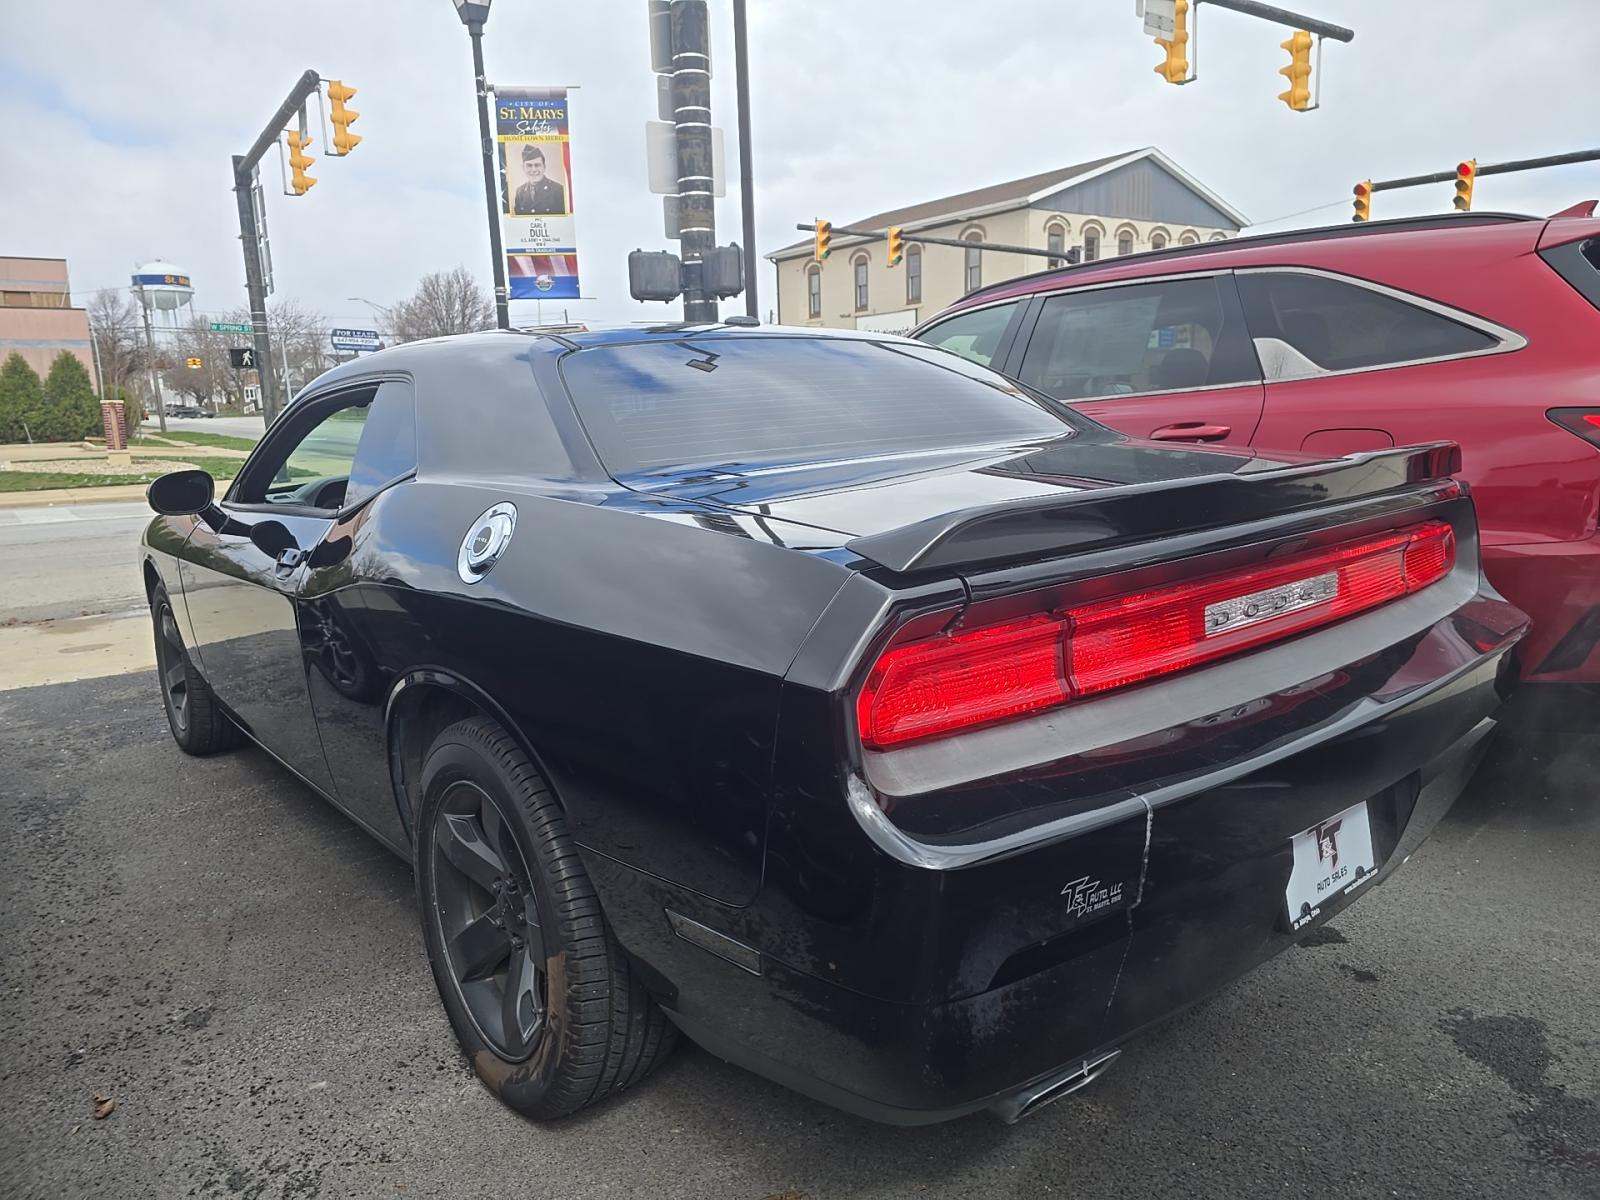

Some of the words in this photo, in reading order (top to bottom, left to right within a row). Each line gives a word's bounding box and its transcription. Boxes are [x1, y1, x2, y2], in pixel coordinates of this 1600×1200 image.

[500, 107, 517, 120] ST.
[519, 107, 564, 120] MARYS
[516, 119, 552, 135] Salutes
[529, 229, 549, 238] DULL
[1317, 877, 1331, 894] AUTO
[1332, 865, 1347, 884] SALES
[1109, 882, 1123, 896] LLC
